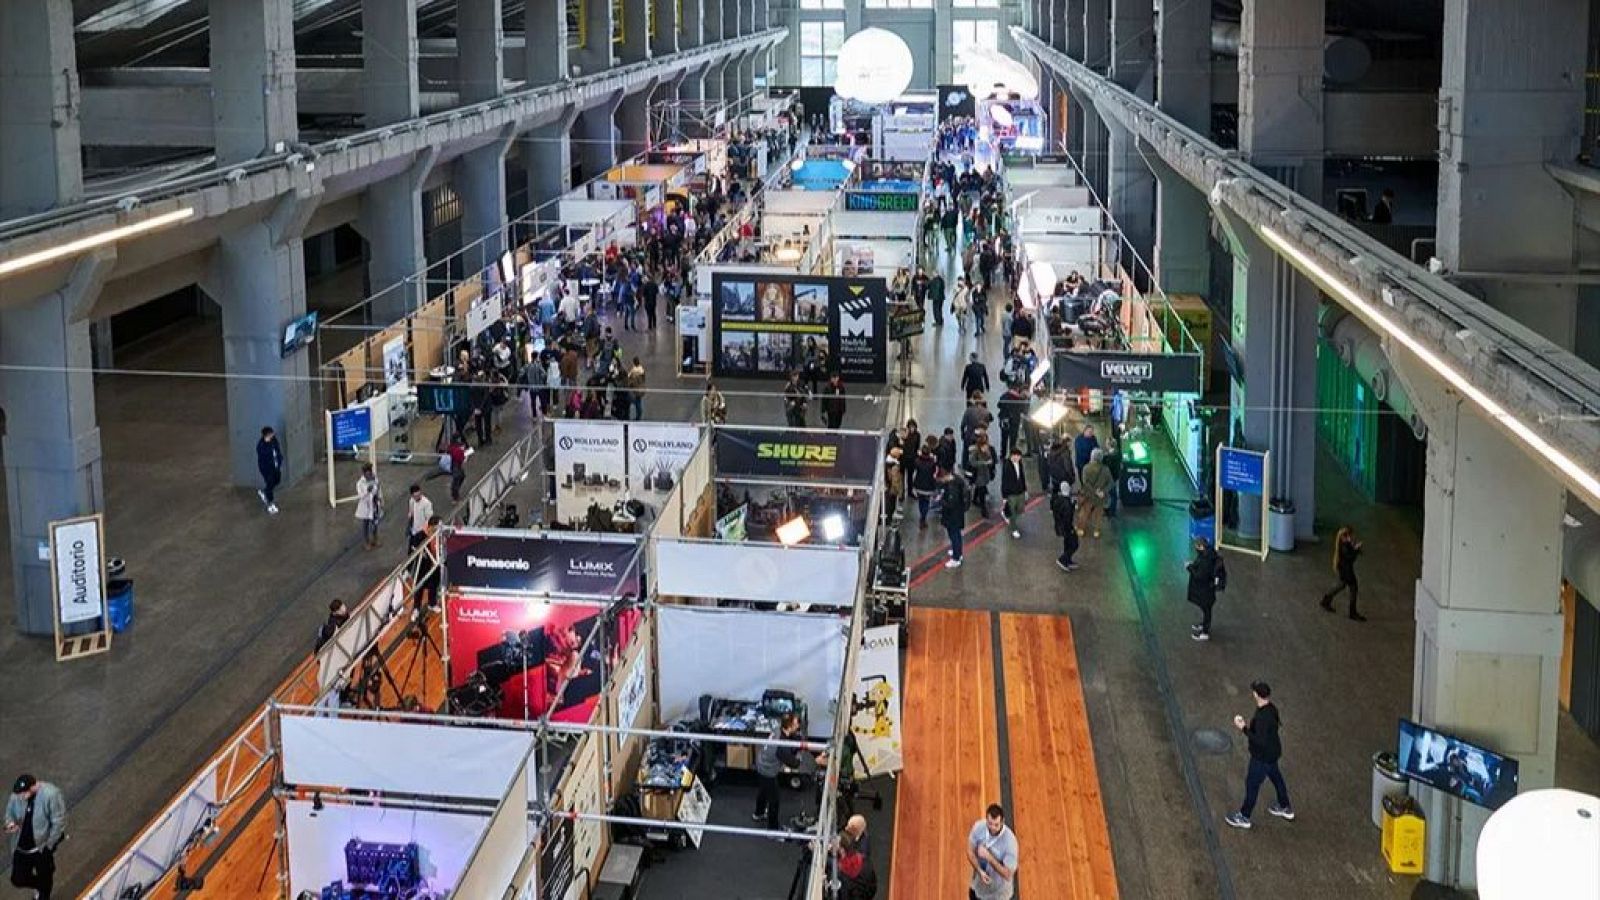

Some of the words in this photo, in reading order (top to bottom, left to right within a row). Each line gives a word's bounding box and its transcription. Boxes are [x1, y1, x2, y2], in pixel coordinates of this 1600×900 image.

[1105, 363, 1148, 376] VELVET
[574, 438, 619, 446] HOLLYLAND
[648, 441, 693, 450] HOLLYLAND
[757, 443, 837, 461] SHURE
[467, 555, 530, 571] Panasonic
[570, 558, 614, 572] LUMIX
[70, 540, 88, 604] Auditorio
[459, 607, 499, 618] LUMIX
